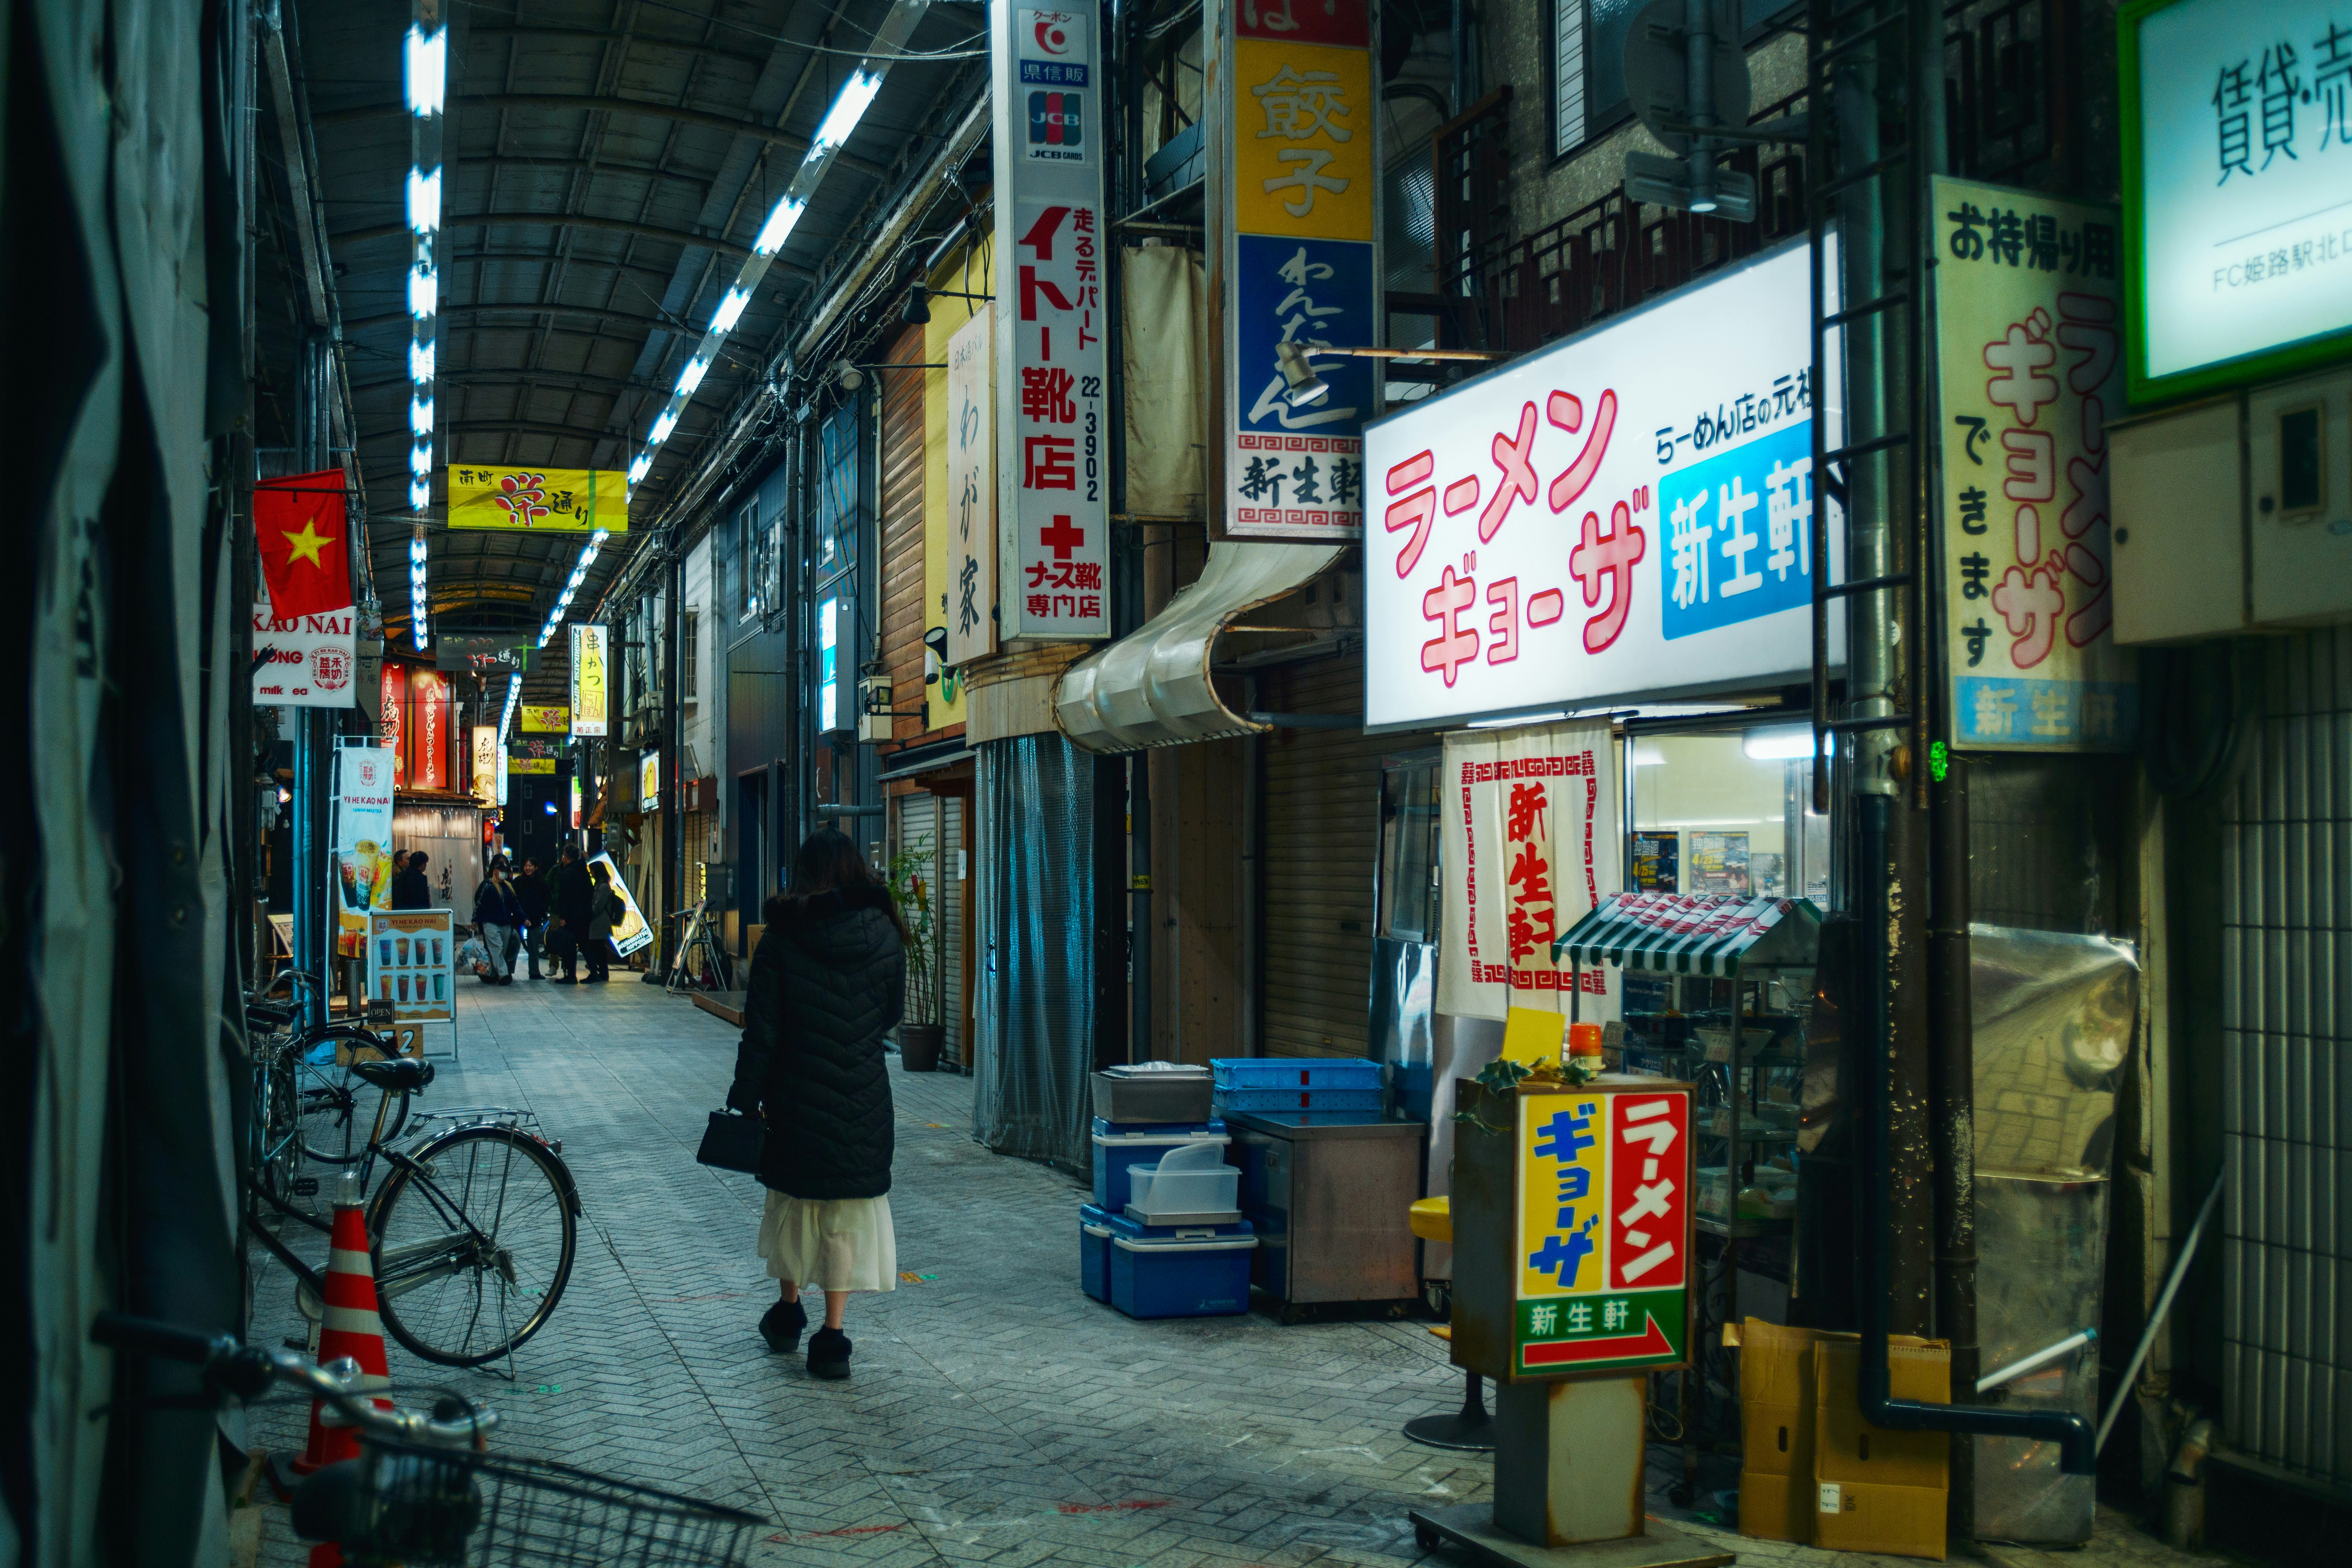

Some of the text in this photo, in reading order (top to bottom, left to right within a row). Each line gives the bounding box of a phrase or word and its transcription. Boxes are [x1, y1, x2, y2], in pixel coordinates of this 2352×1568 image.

[1033, 10, 1072, 22] クーポン
[1024, 64, 1084, 82] 県信販
[1030, 150, 1082, 160] JCB CARDS
[1031, 112, 1079, 126] JCB
[1252, 63, 1352, 218] 餃子
[1073, 207, 1098, 350] 走るデパート
[1947, 202, 2115, 280] お持帰り用
[1019, 206, 1076, 490] イトー靴店
[1081, 376, 1100, 501] 22-3902
[460, 470, 494, 486] 南町
[959, 384, 980, 638] わが家
[1385, 389, 1617, 578] ラーメン
[1983, 307, 2065, 669] ギョーザ
[1669, 456, 1812, 610] 新生軒
[1954, 415, 1993, 668] できます
[1025, 561, 1102, 590] ナース靴
[1027, 594, 1100, 618] 専門店
[1421, 486, 1649, 689] ギョーザ
[306, 616, 352, 635] NAI
[587, 631, 604, 686] 串かつ
[260, 686, 283, 695] milk
[1508, 781, 1557, 968] 新生軒
[618, 928, 649, 949] KUSHIKATSU
[626, 937, 647, 951] NIPPON
[1528, 1102, 1599, 1288] ギョーザ
[1618, 1099, 1678, 1284] ラーメン
[1531, 1301, 1629, 1335] 新生軒
